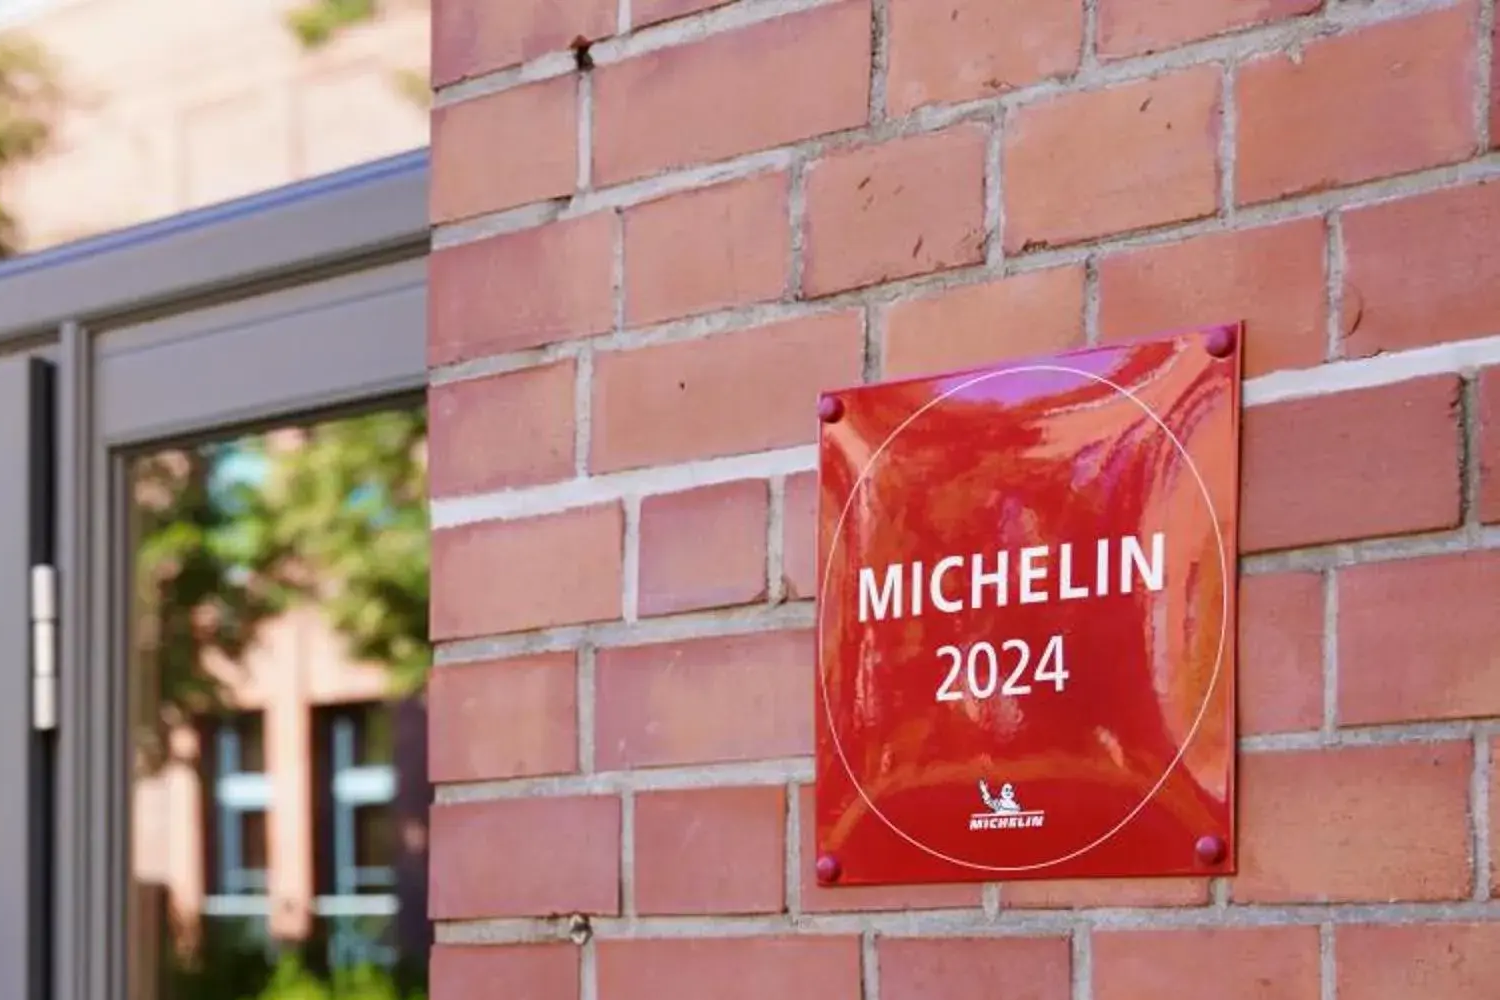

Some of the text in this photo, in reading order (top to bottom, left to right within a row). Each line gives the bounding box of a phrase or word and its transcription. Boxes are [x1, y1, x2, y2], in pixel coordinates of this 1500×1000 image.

[857, 532, 1166, 623] MICHELIN
[935, 635, 1070, 702] 2024
[969, 814, 1045, 832] MICHELIN
